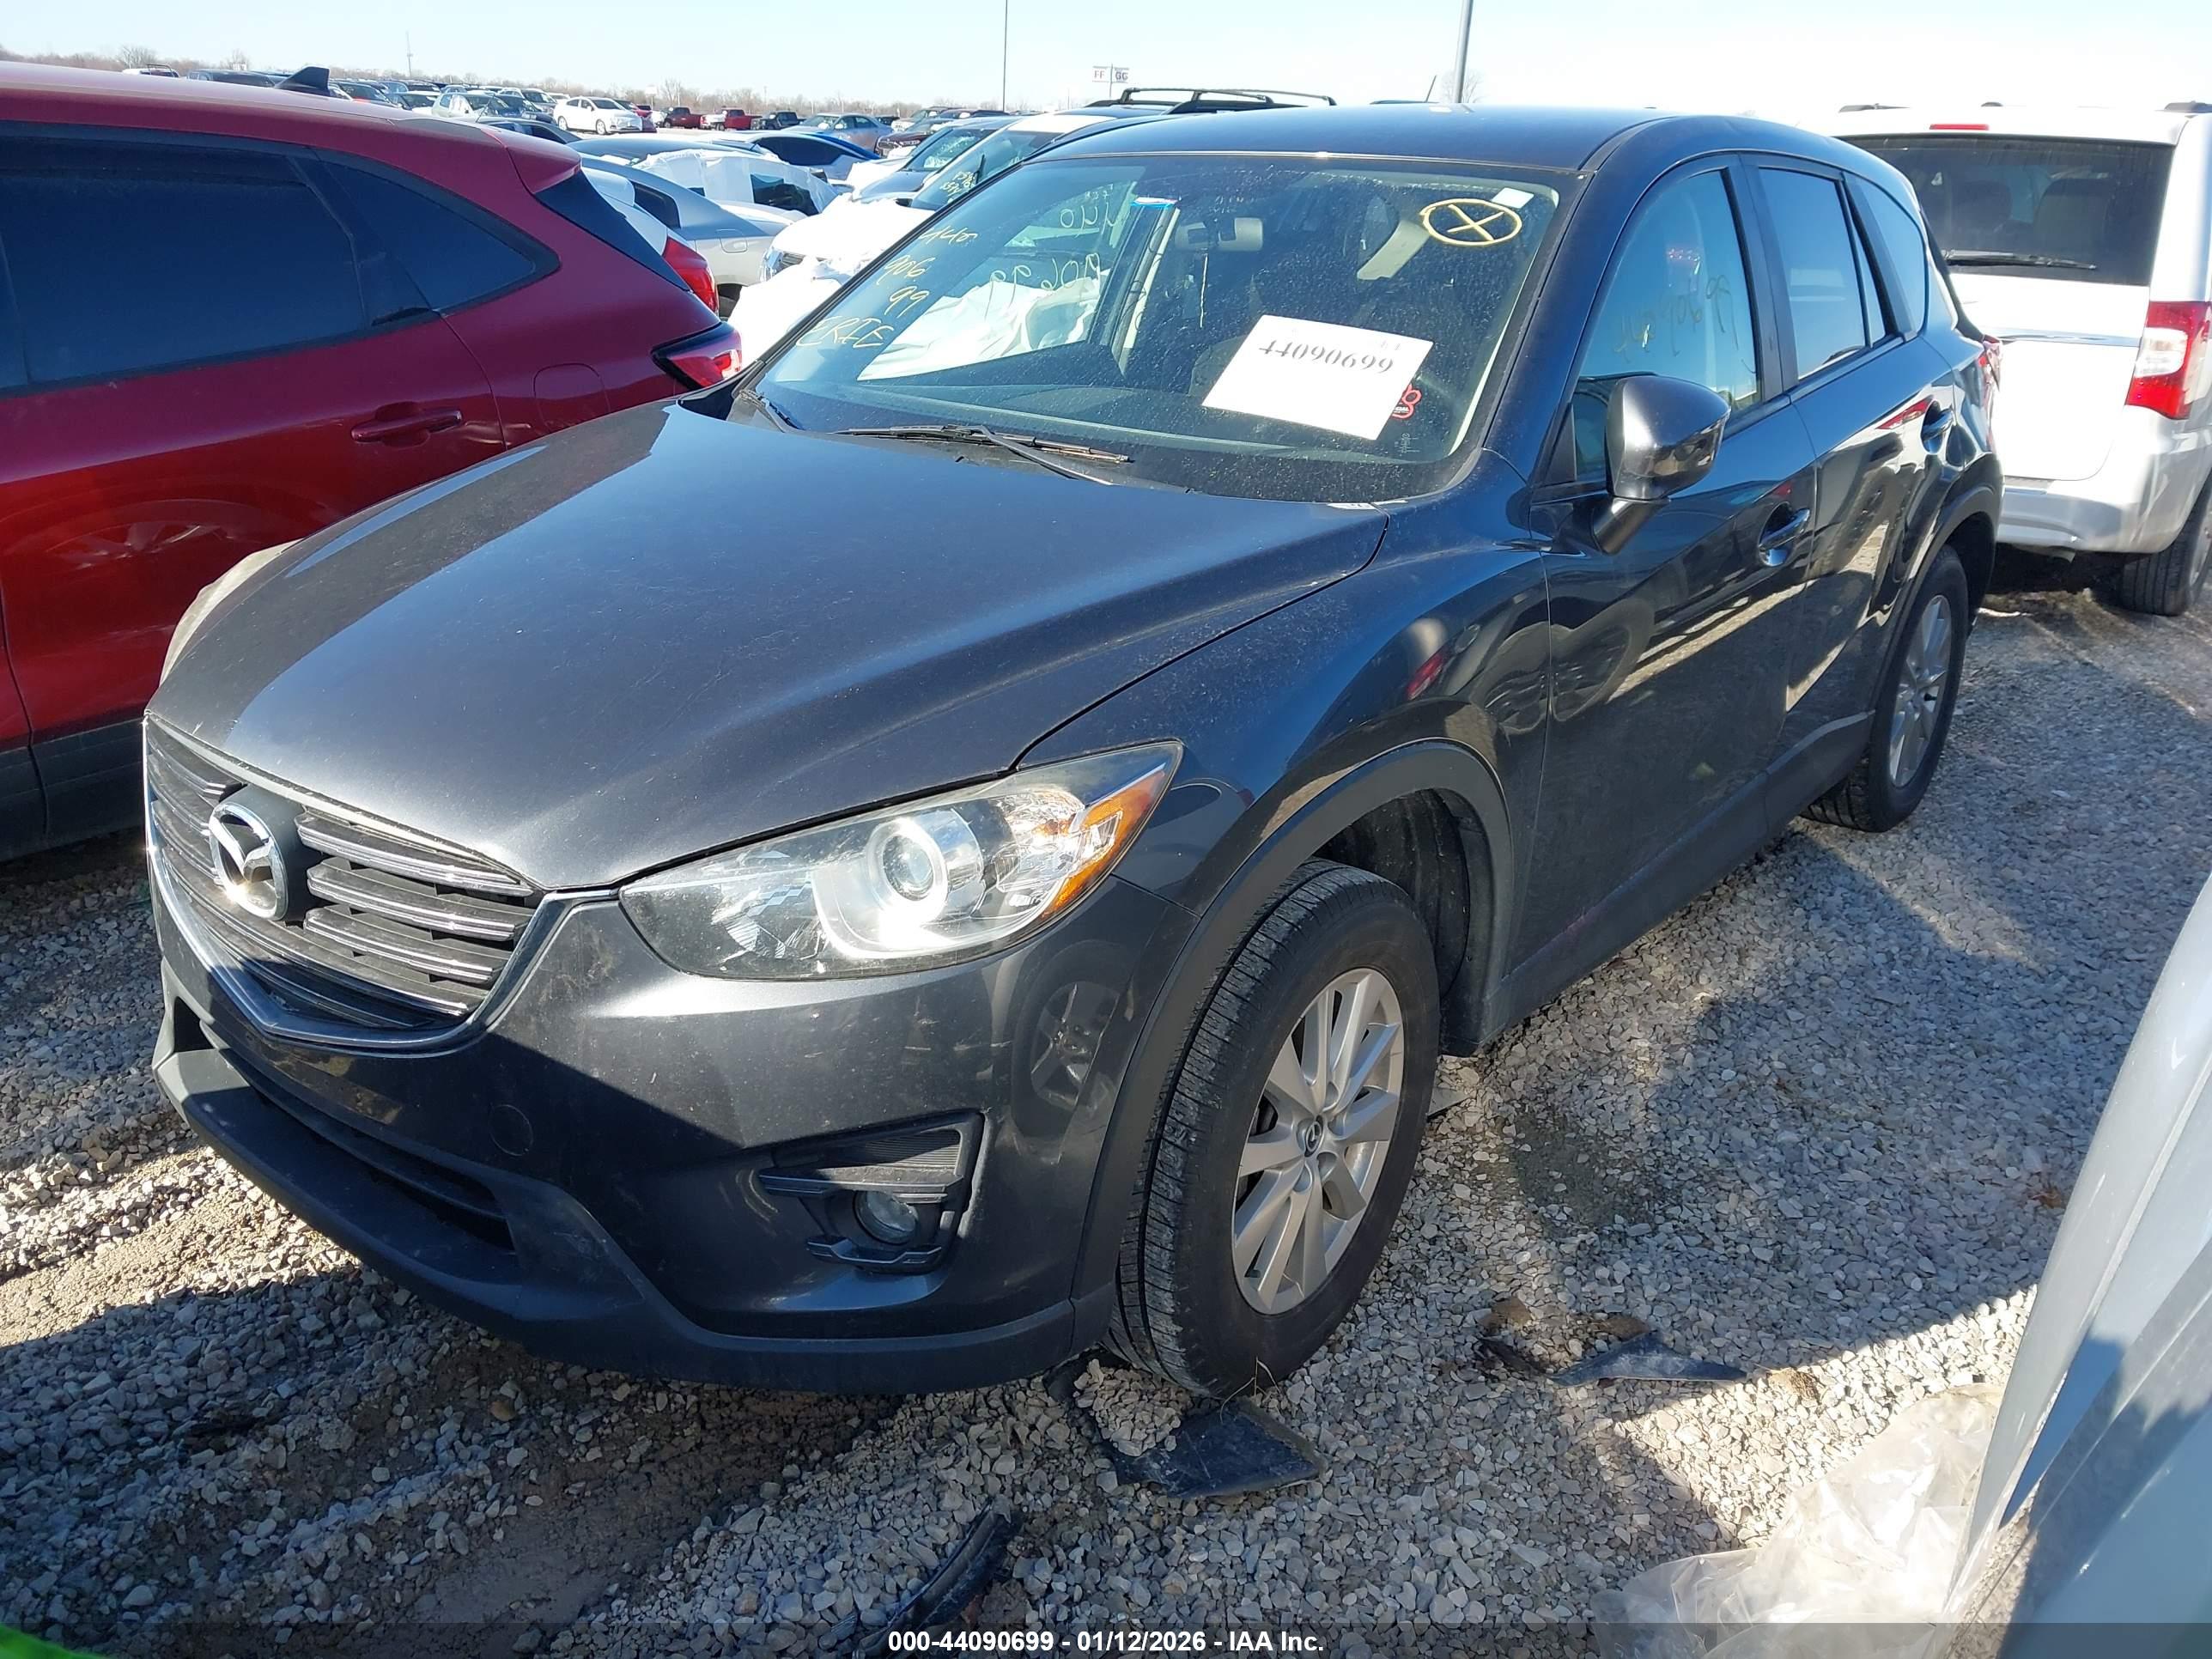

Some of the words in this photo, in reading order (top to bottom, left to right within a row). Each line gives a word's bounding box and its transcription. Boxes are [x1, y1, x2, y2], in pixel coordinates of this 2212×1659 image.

[1093, 70, 1106, 79] FF
[884, 285, 931, 319] 99
[795, 315, 895, 349] ERIE
[1258, 339, 1395, 374] 44090699
